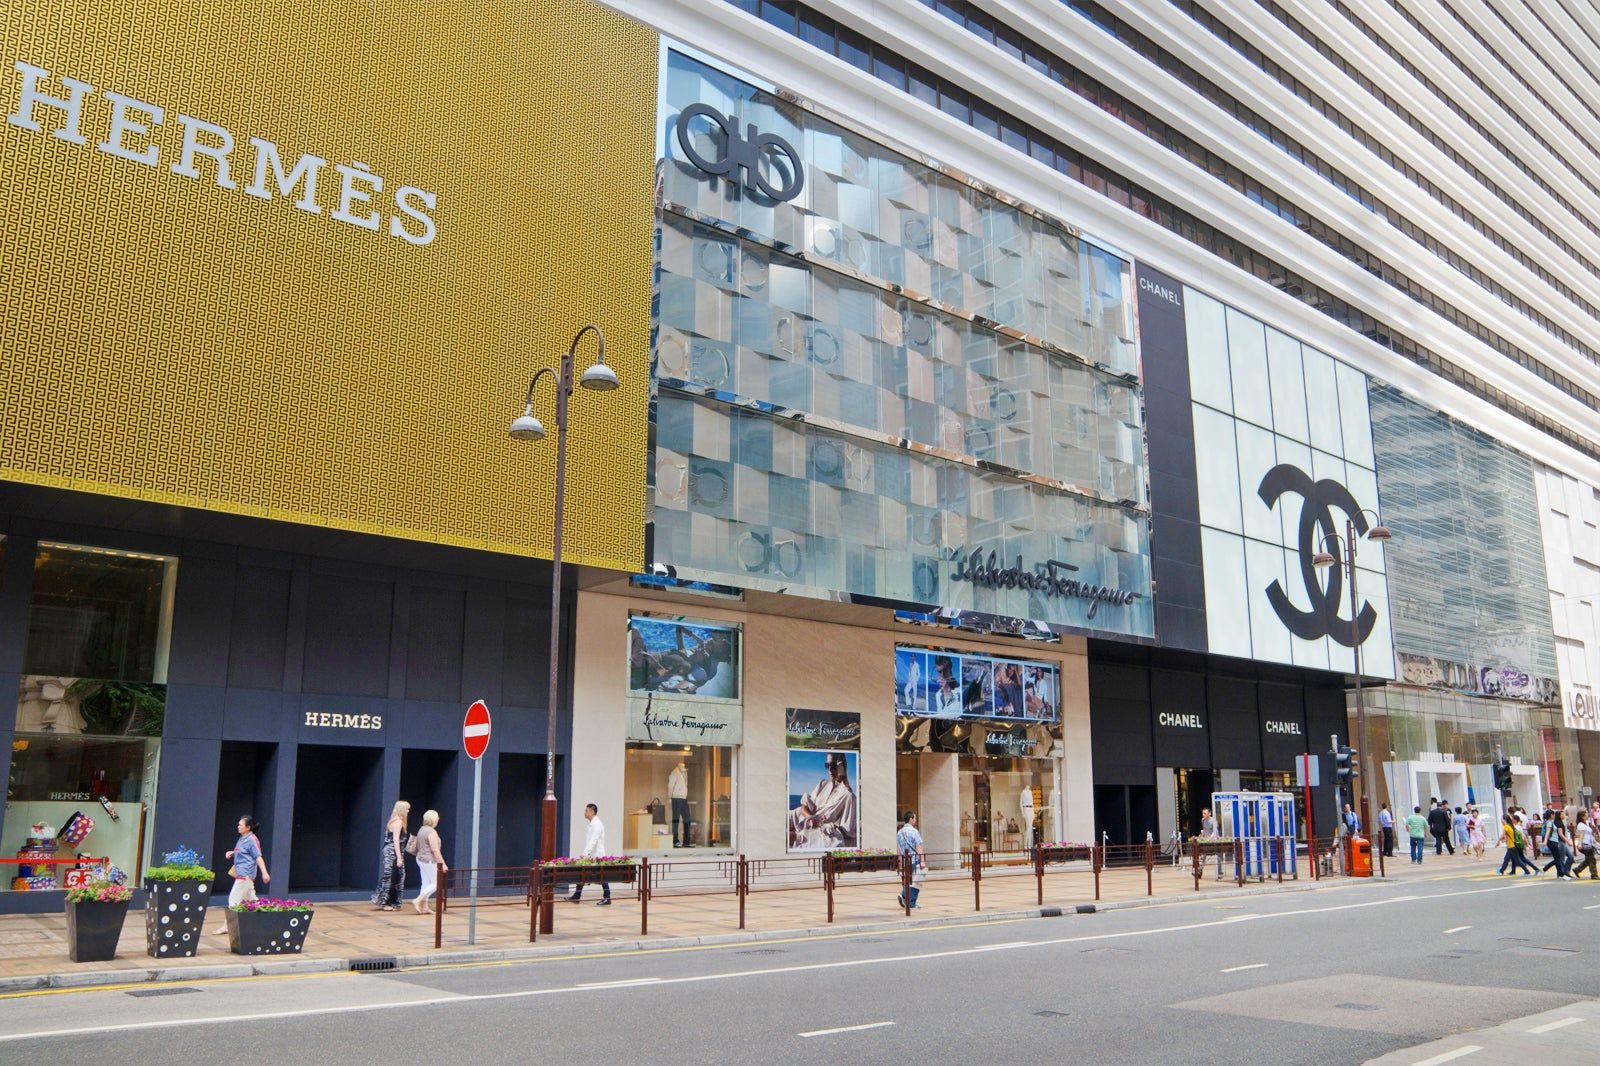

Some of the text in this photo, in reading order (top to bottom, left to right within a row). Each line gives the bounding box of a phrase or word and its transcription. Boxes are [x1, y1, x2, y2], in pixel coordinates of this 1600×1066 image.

[7, 60, 438, 246] HERMÈS
[1139, 277, 1181, 306] CHANEL
[681, 715, 727, 737] Ferragamo
[1158, 712, 1203, 729] CHANEL
[1265, 720, 1302, 735] CHANEL
